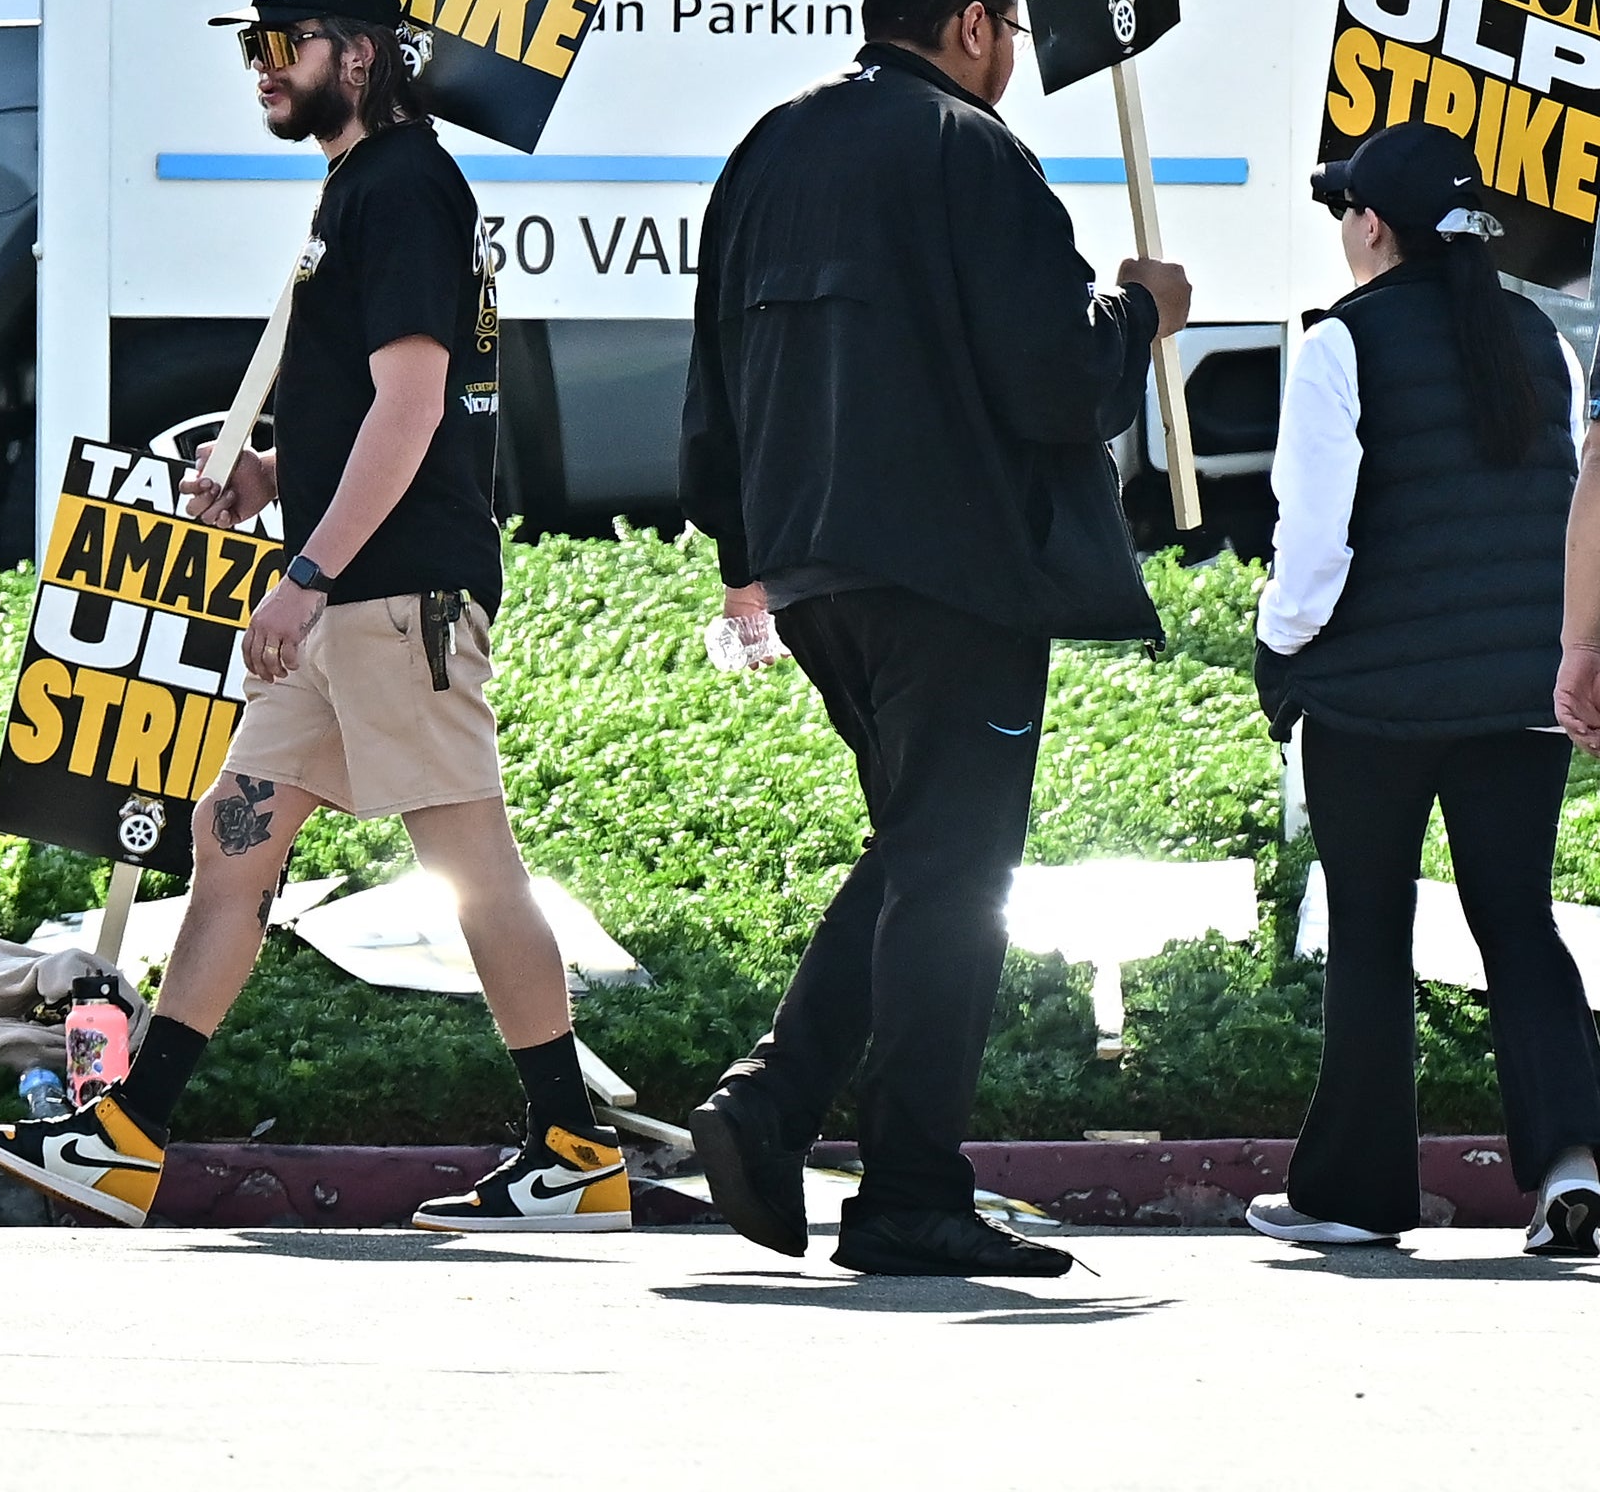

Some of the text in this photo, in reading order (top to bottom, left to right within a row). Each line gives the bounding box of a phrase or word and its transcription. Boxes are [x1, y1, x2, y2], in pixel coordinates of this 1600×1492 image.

[1328, 26, 1600, 223] STRIKE
[484, 215, 698, 275] 30 VAL
[33, 584, 246, 701] UL
[9, 658, 238, 802] STRI
